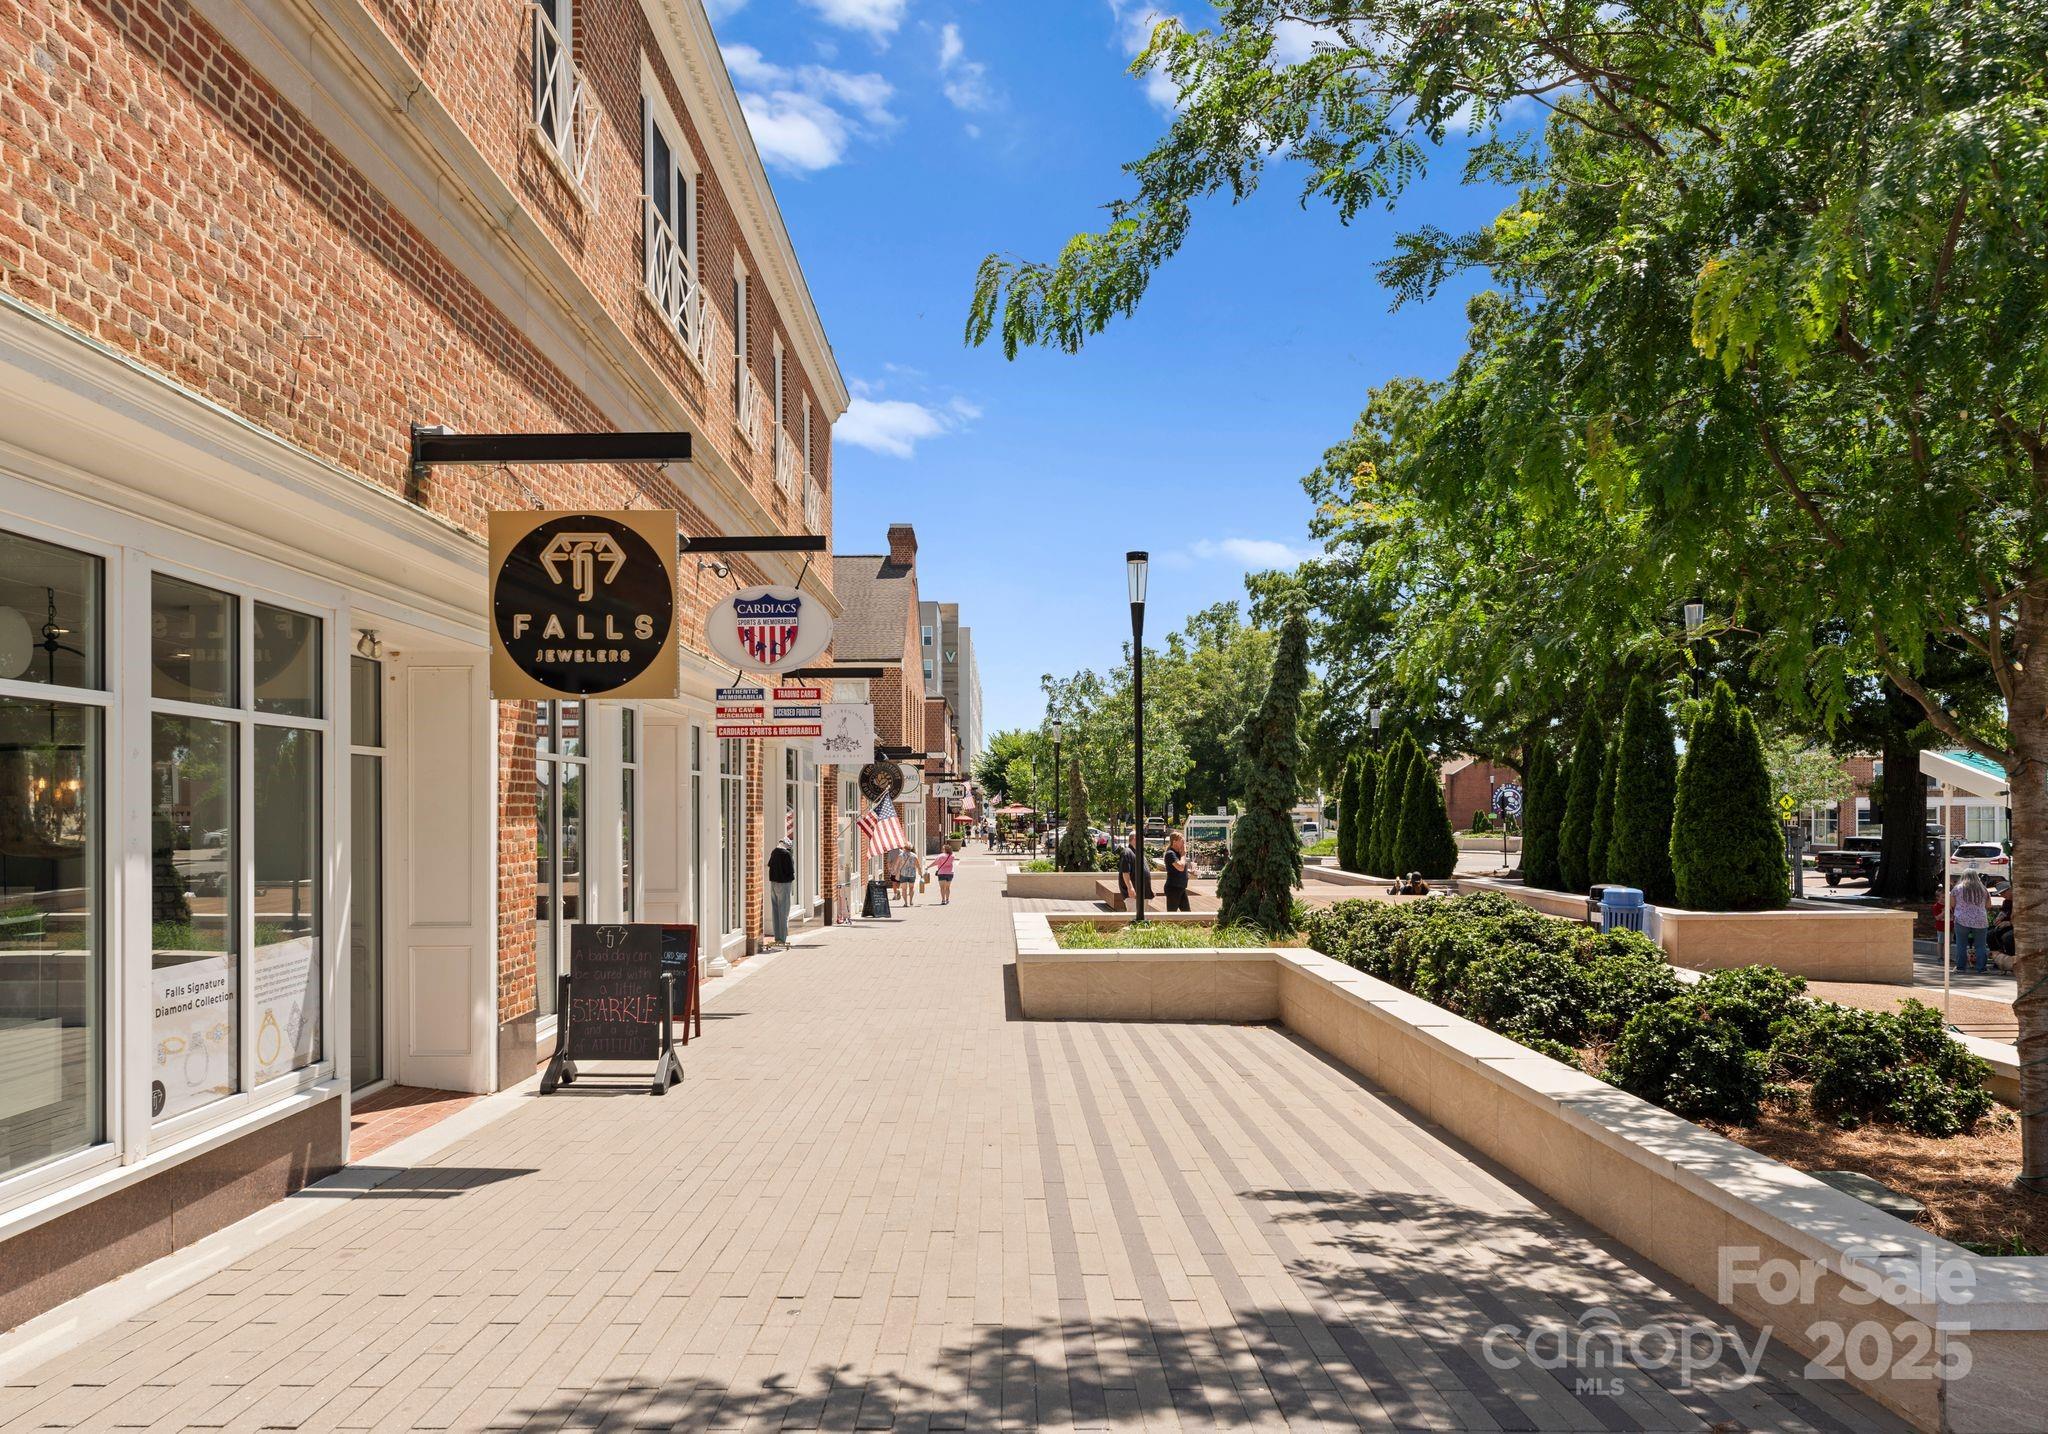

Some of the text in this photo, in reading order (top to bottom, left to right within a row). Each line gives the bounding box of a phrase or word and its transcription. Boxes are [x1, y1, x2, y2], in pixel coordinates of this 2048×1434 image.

[737, 603, 797, 614] CARDIACS
[513, 613, 654, 640] FALLS
[737, 618, 757, 626] SPORTS
[762, 617, 797, 625] MEMORABILIA
[536, 649, 631, 663] JEWELERS
[777, 690, 818, 698] TRADING CARDS
[774, 707, 795, 717] LICENSED
[795, 707, 821, 717] FURNITURE
[718, 726, 820, 736] CARDIACS SPORTS & MEMORABILIA
[588, 949, 609, 961] bad
[611, 949, 631, 965] day
[633, 951, 652, 962] can
[594, 967, 622, 980] cured
[626, 966, 652, 979] with
[165, 978, 225, 999] Falls Signature
[615, 981, 642, 996] little
[155, 992, 234, 1018] Diamond Collection
[572, 994, 657, 1024] SPARKLE
